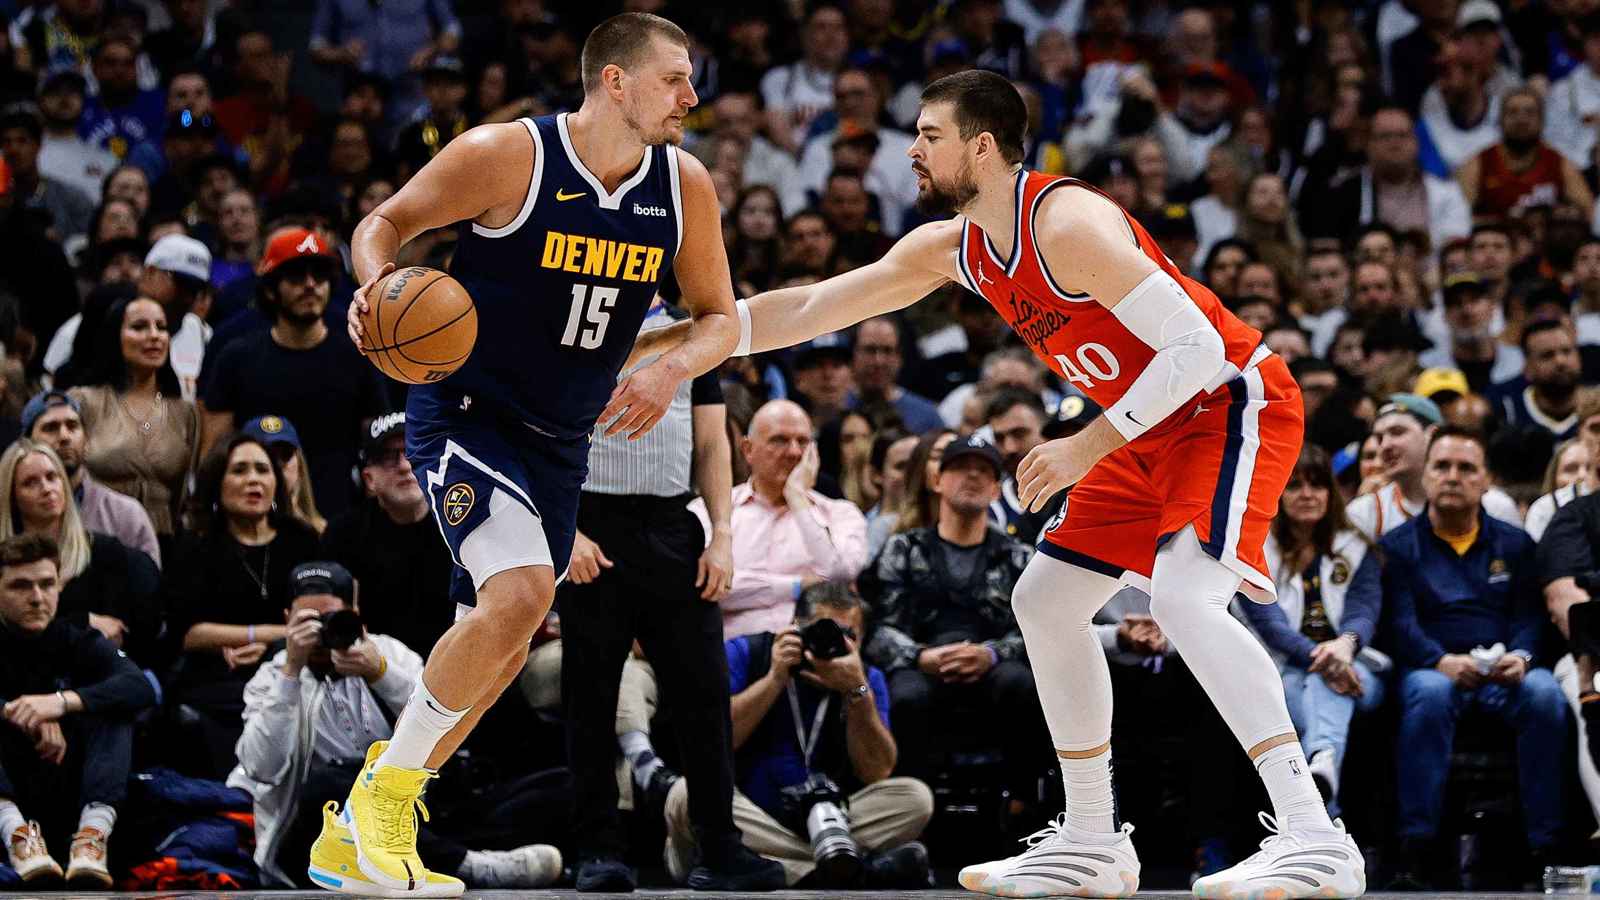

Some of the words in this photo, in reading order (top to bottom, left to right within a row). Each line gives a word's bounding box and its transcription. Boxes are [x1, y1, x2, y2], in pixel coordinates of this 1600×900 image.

[633, 203, 667, 217] ibotta
[541, 231, 664, 282] DENVER
[560, 283, 620, 350] 15
[1053, 342, 1120, 388] 40
